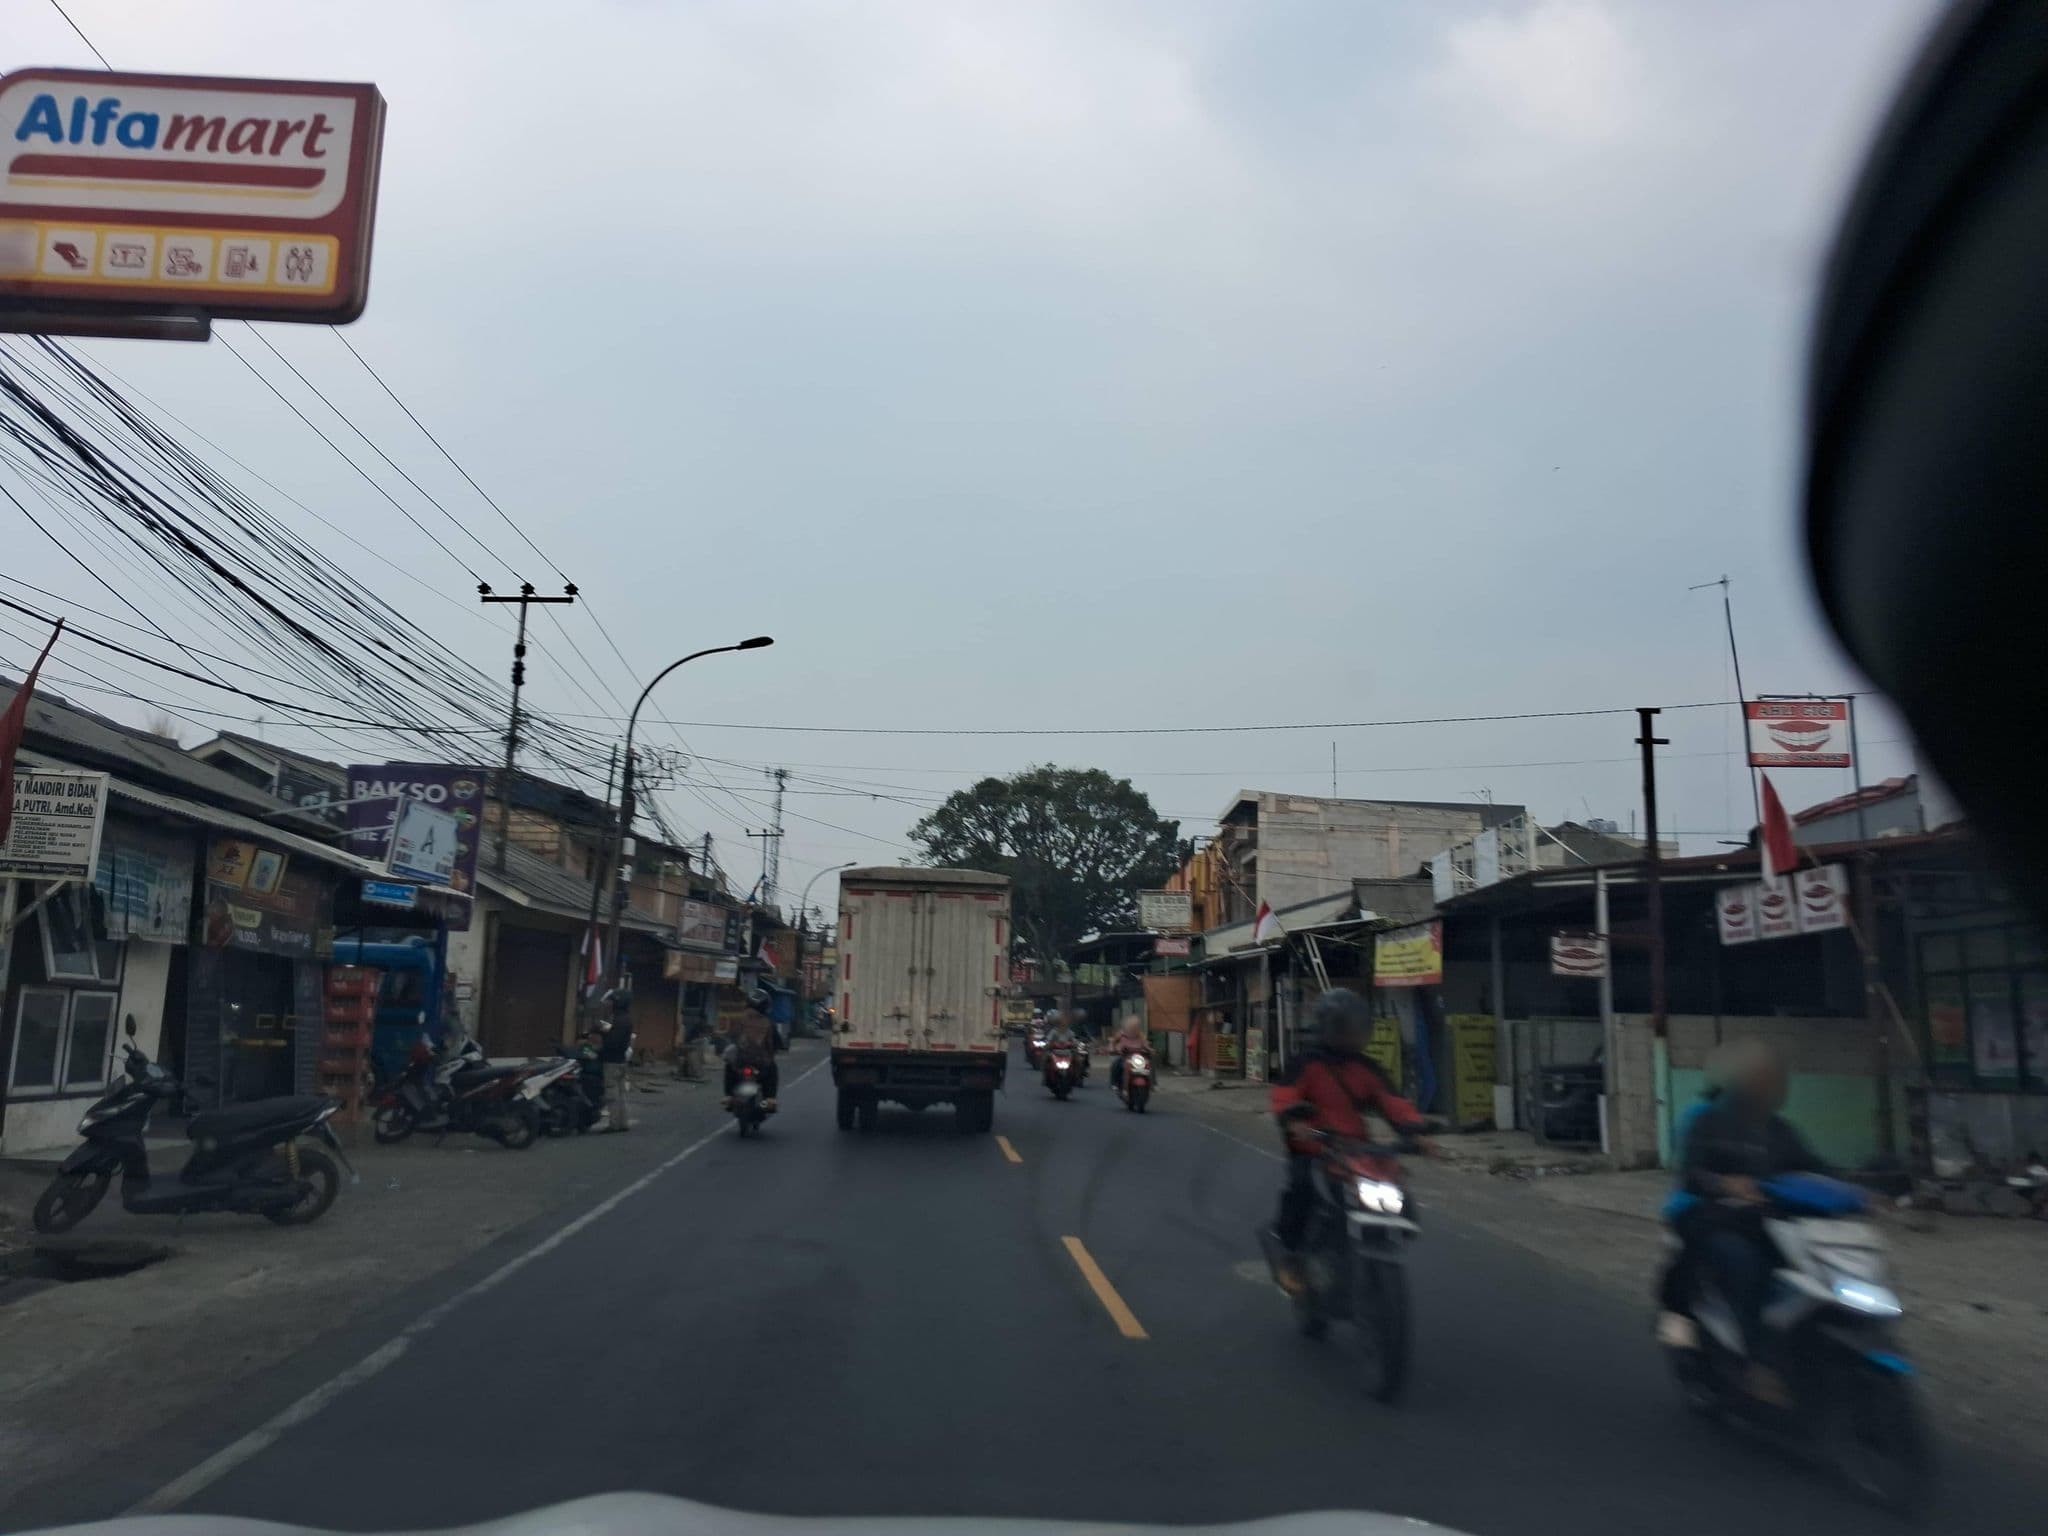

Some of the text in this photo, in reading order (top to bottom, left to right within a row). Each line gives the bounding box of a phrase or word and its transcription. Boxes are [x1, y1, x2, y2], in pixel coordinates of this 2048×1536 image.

[15, 93, 335, 158] Alfamart
[24, 780, 66, 797] MANDIRI
[67, 782, 97, 799] BIDAN
[352, 780, 448, 803] BAKSO
